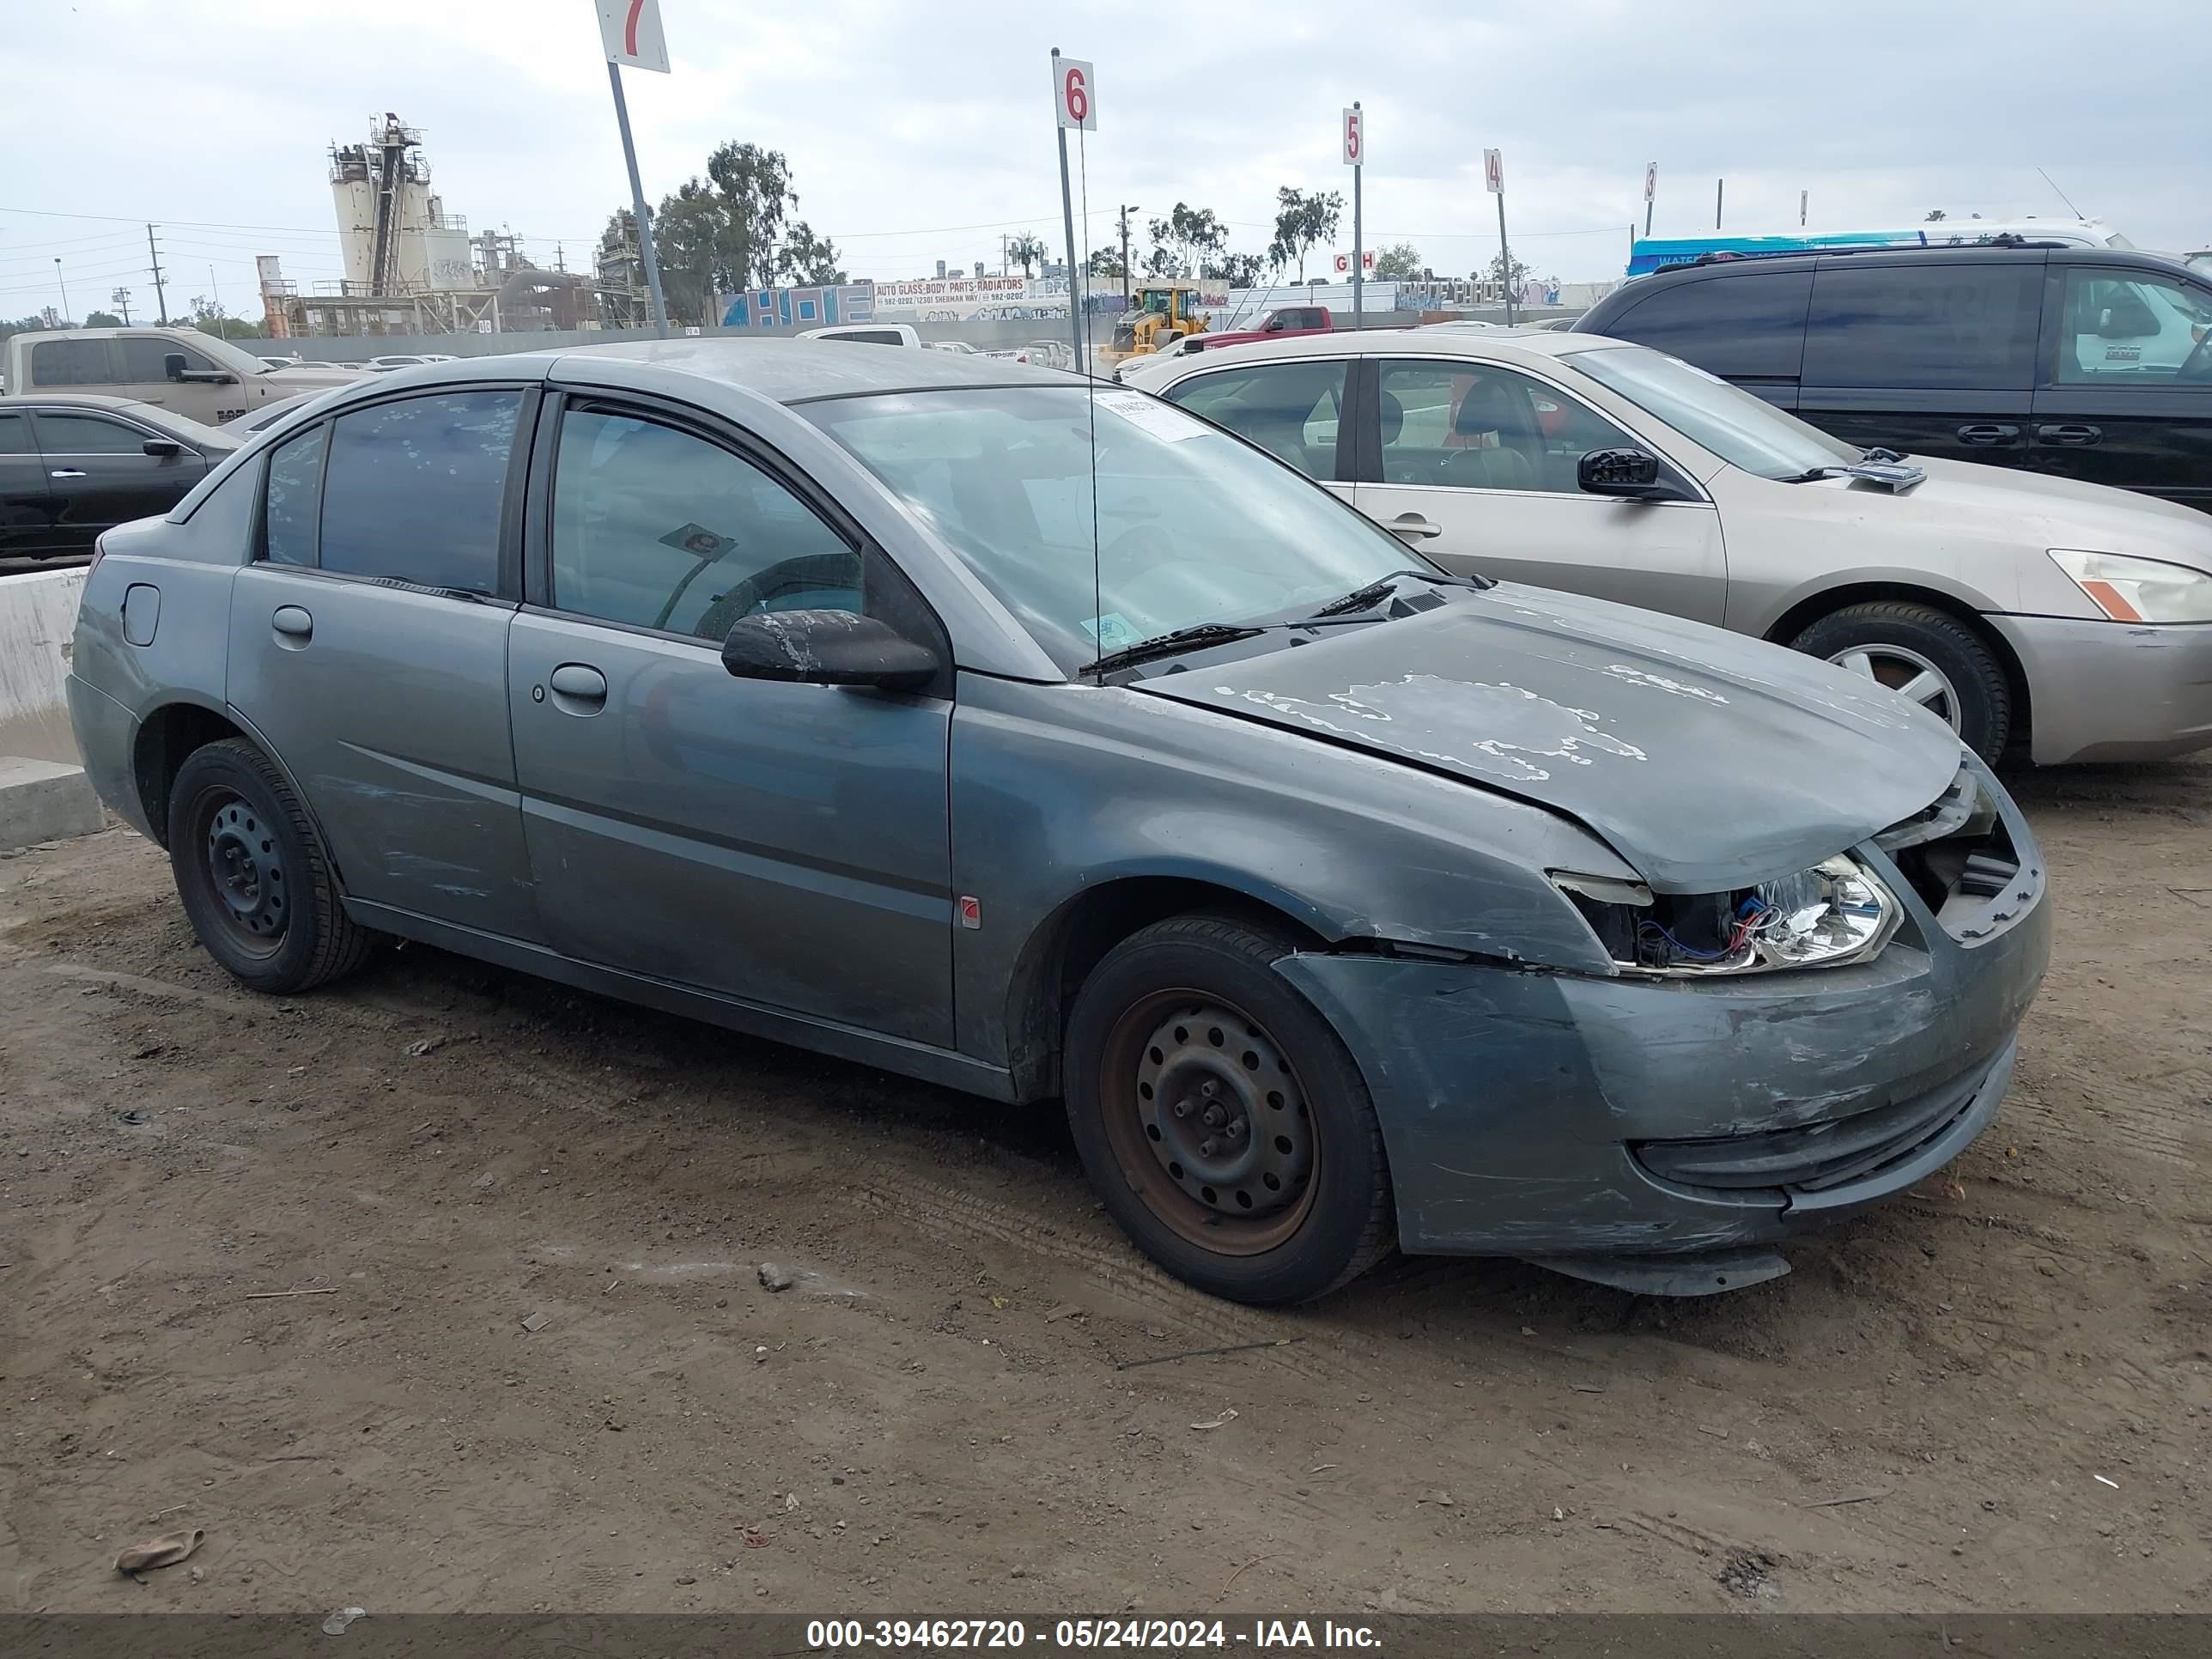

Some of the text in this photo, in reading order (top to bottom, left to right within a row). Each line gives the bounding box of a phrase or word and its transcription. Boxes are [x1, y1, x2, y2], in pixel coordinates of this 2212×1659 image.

[1065, 68, 1089, 121] 6
[1347, 116, 1359, 159] 5
[1490, 155, 1500, 188] 4
[1647, 168, 1656, 198] 3
[1336, 256, 1347, 271] G
[1363, 253, 1373, 268] H
[877, 285, 896, 296] AUTO
[977, 279, 1024, 292] RADIATORS
[935, 295, 963, 303] SHERMAN
